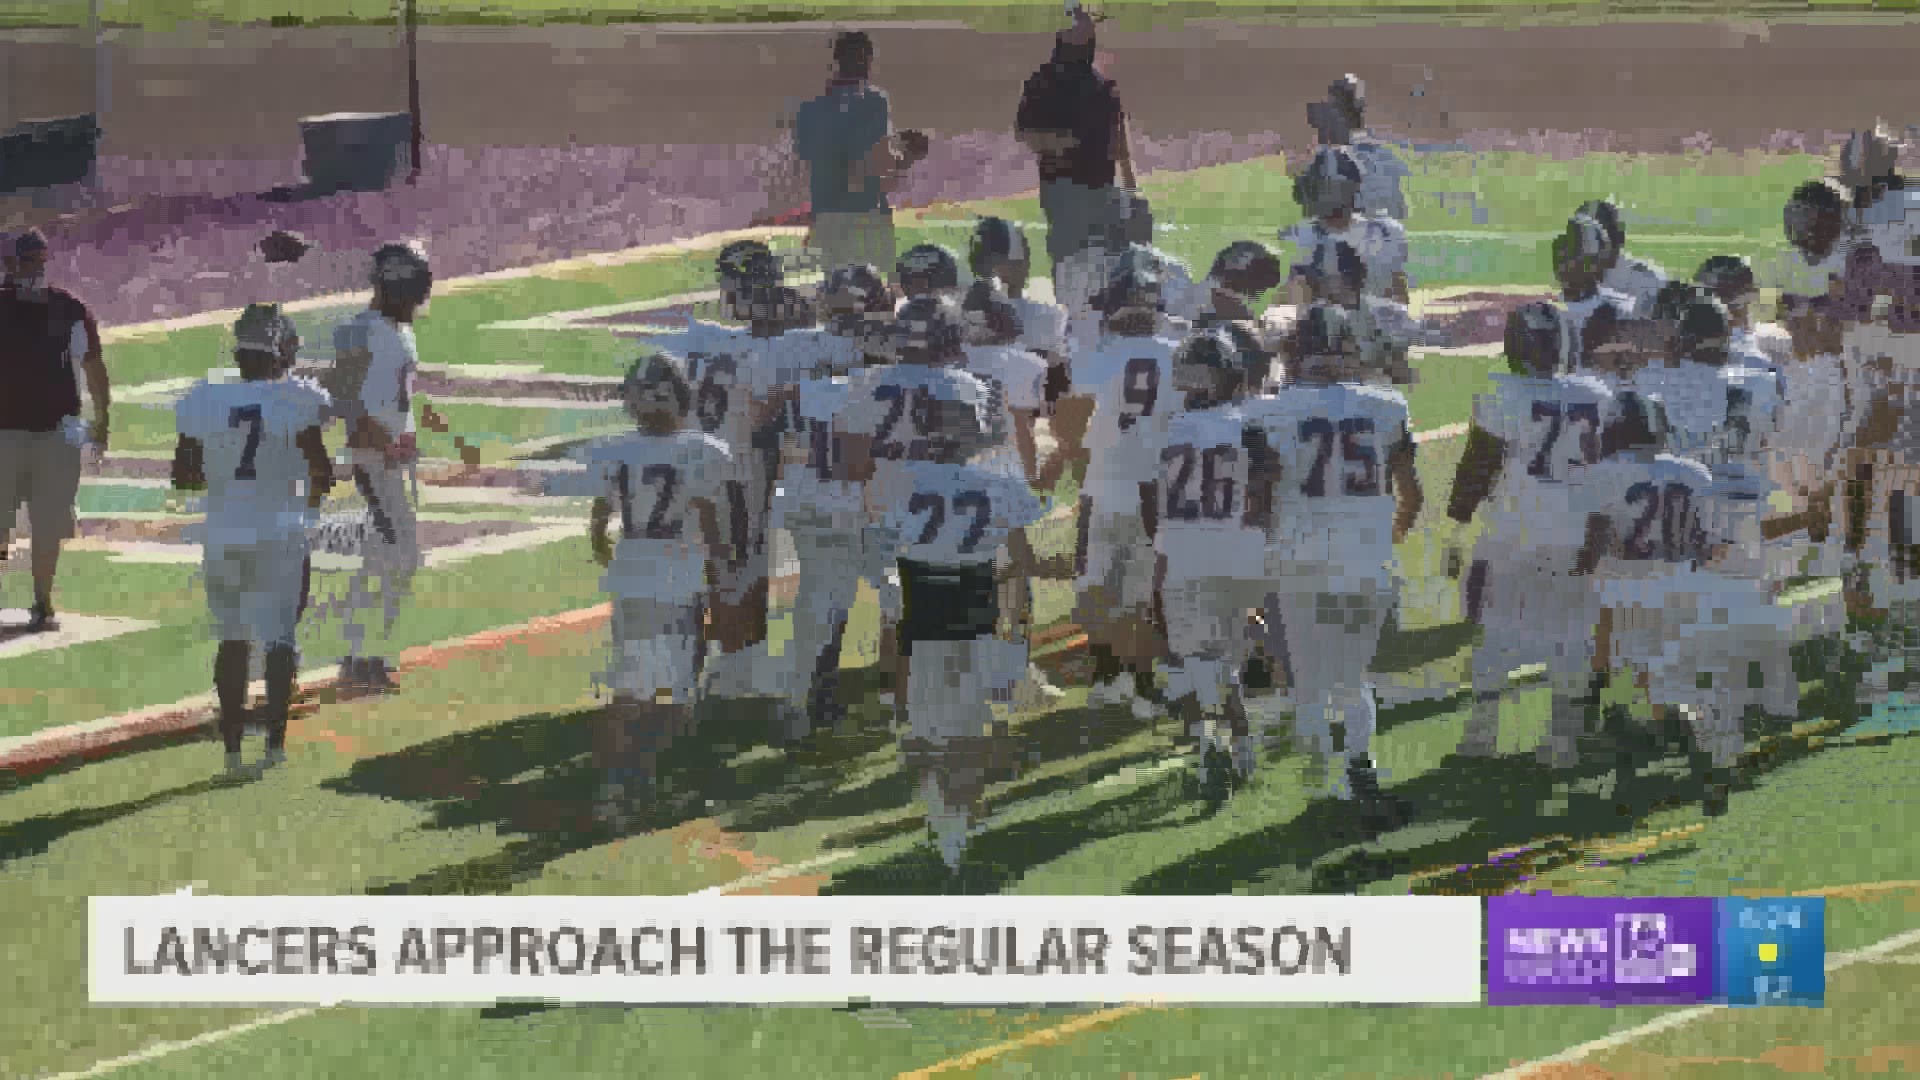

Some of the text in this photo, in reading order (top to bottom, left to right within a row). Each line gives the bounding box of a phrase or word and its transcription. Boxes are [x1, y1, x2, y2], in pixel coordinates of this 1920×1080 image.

[1119, 358, 1160, 430] 9
[229, 403, 263, 480] 7
[1297, 416, 1378, 497] 75
[1159, 443, 1239, 519] 26
